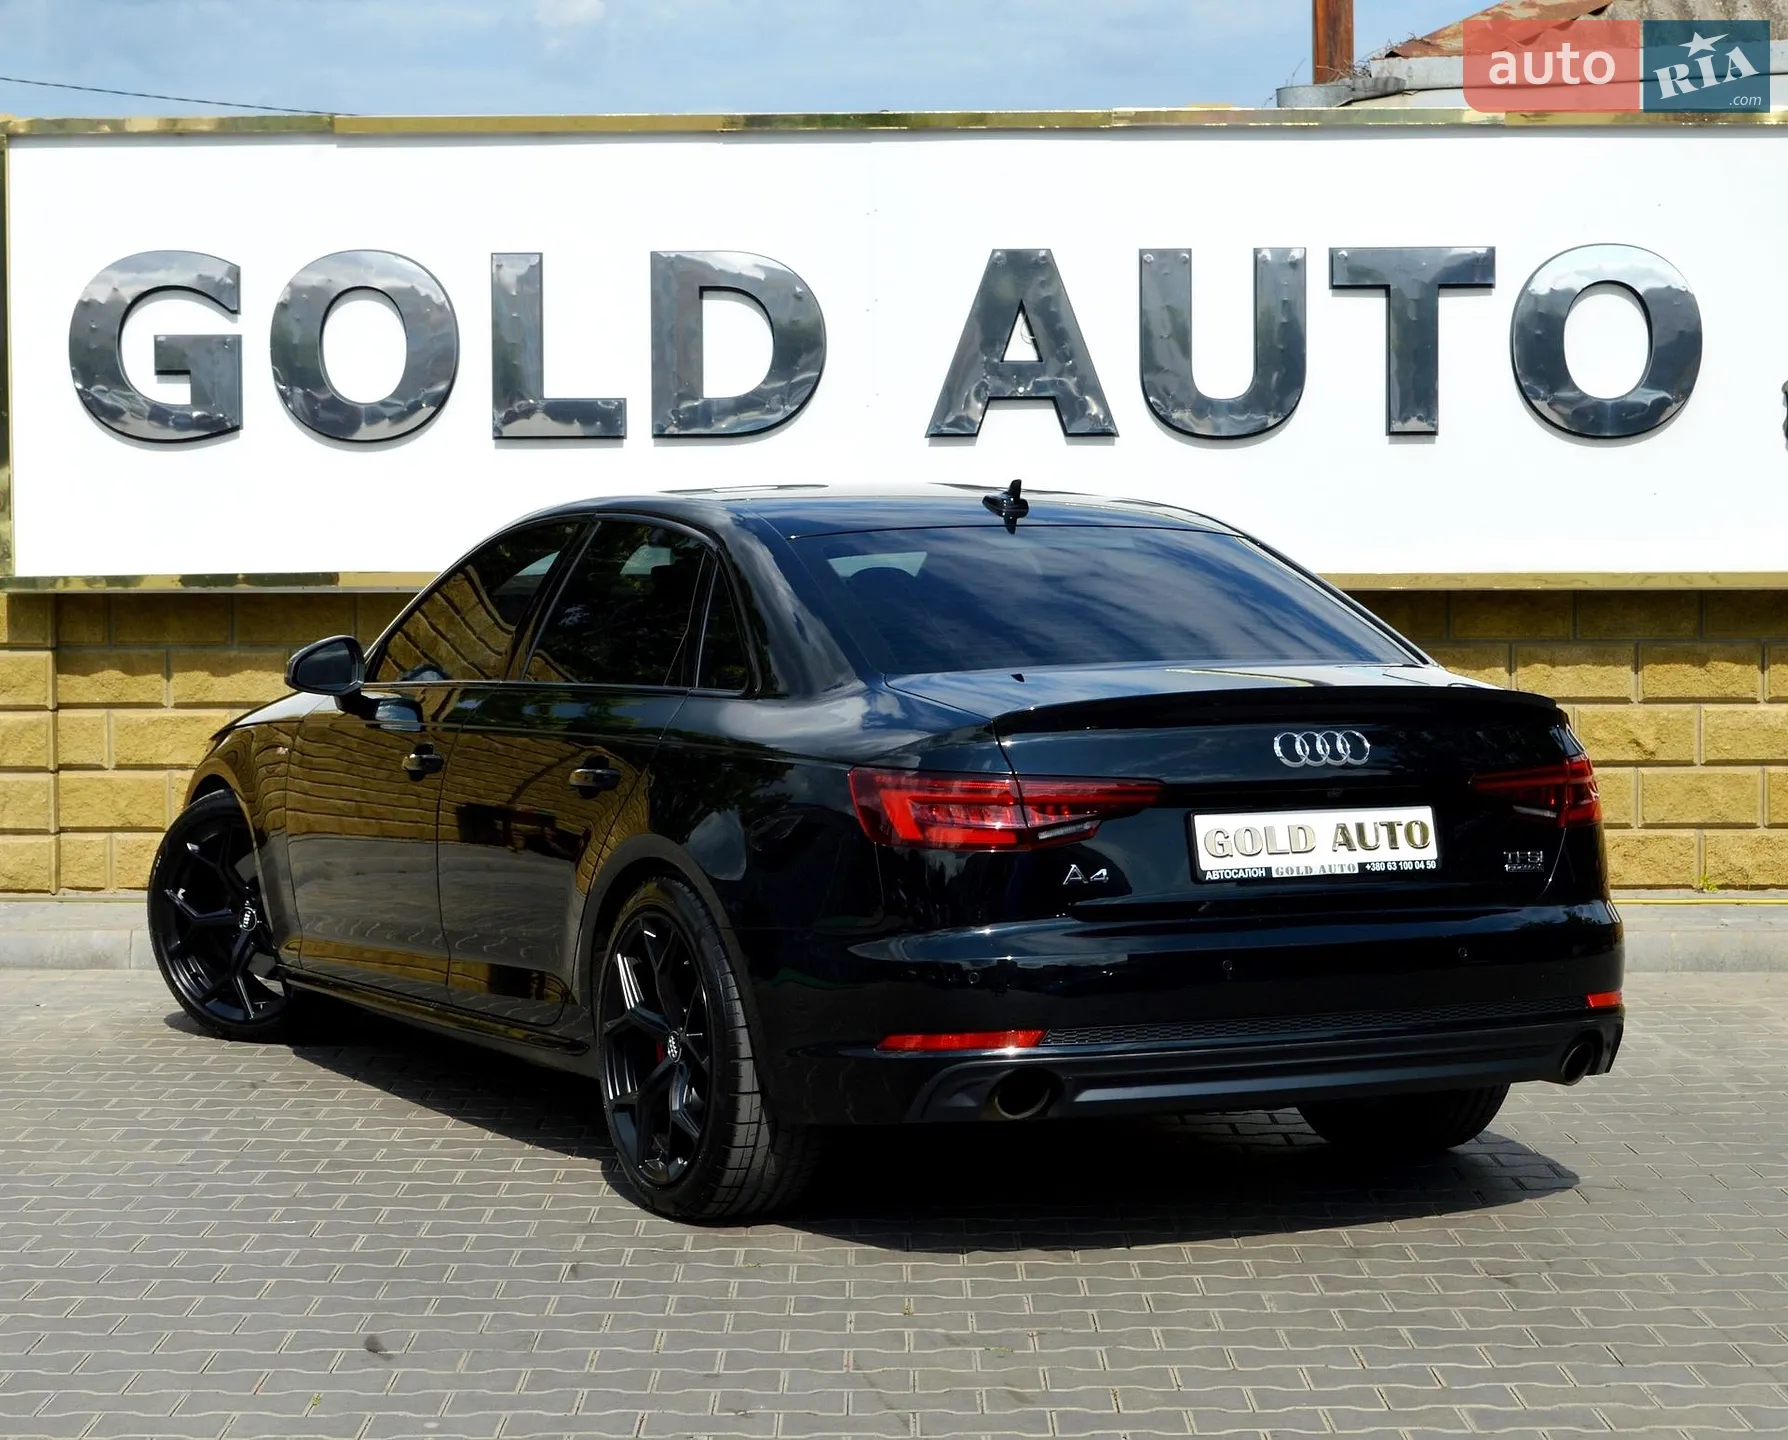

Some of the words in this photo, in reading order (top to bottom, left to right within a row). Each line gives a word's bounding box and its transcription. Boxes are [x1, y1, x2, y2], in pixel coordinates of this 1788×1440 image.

[68, 249, 828, 444] GOLD
[924, 243, 1703, 444] AUTO
[1204, 824, 1317, 858] GOLD
[1332, 820, 1431, 852] AUTO
[1205, 867, 1266, 880] АВТОСАЛОН
[1275, 865, 1313, 876] GOLD
[1319, 863, 1356, 874] AUTO
[1365, 861, 1385, 872] +380
[1386, 861, 1397, 871] 63
[1399, 860, 1413, 871] 100
[1414, 860, 1425, 870] 04
[1426, 859, 1436, 869] 50
[1062, 864, 1109, 885] A4
